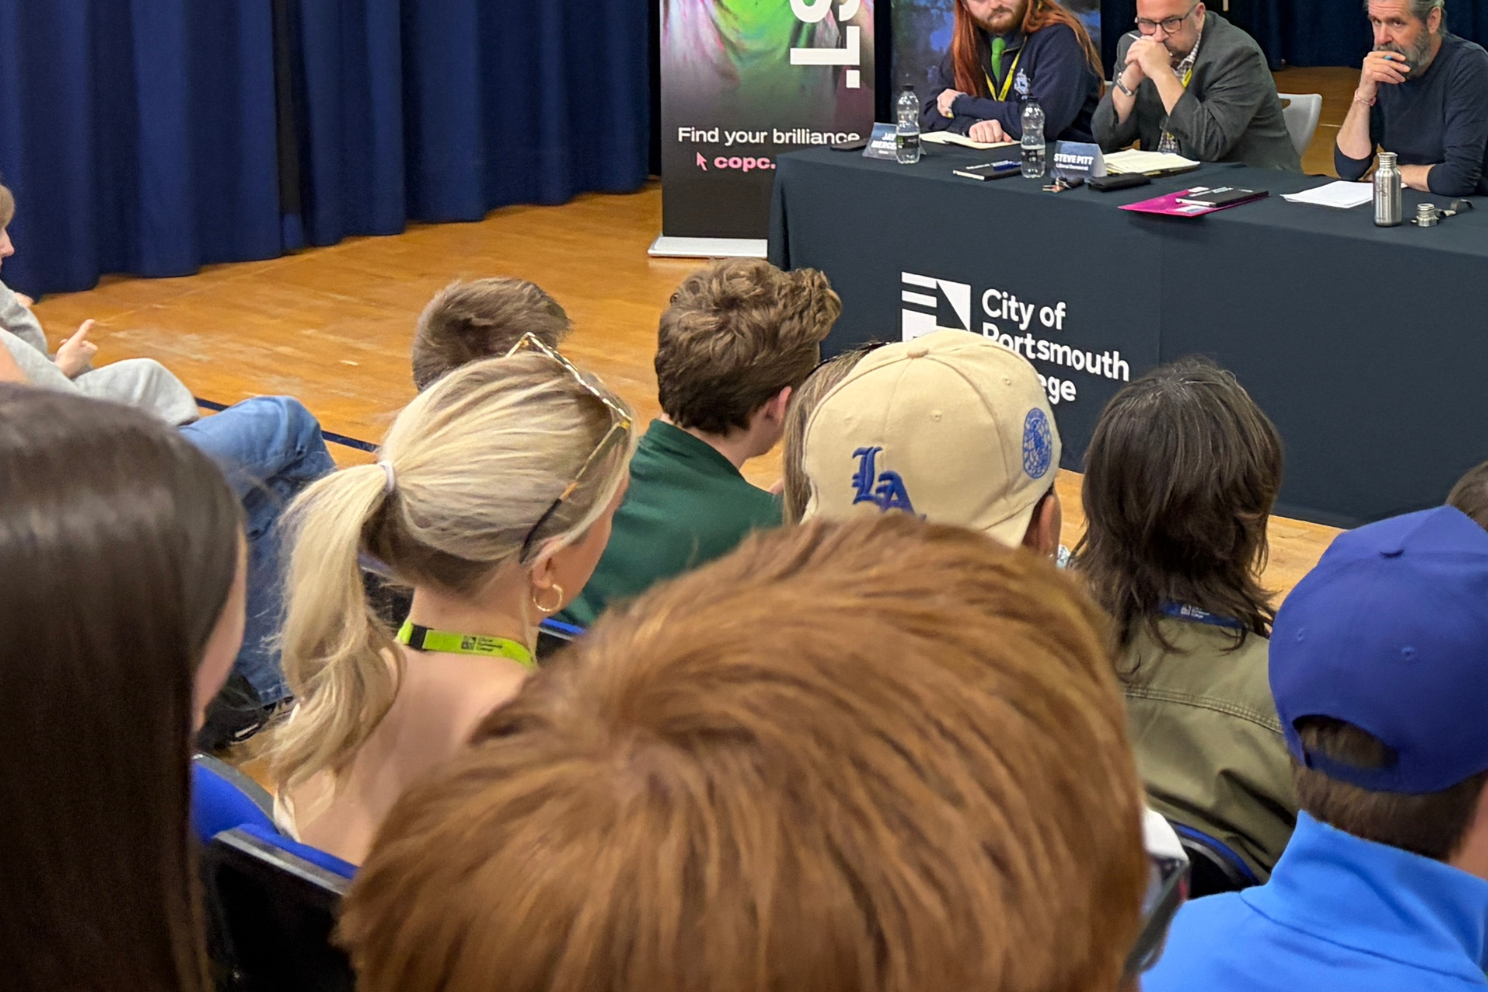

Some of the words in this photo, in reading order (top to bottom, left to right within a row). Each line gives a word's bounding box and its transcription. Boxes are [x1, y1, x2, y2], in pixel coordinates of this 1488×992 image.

[678, 126, 719, 143] Find
[724, 130, 768, 147] your
[773, 128, 860, 145] brilliance
[1053, 153, 1077, 164] STEVE
[1077, 155, 1094, 166] PITT
[982, 288, 1035, 331] City
[1039, 301, 1067, 330] of
